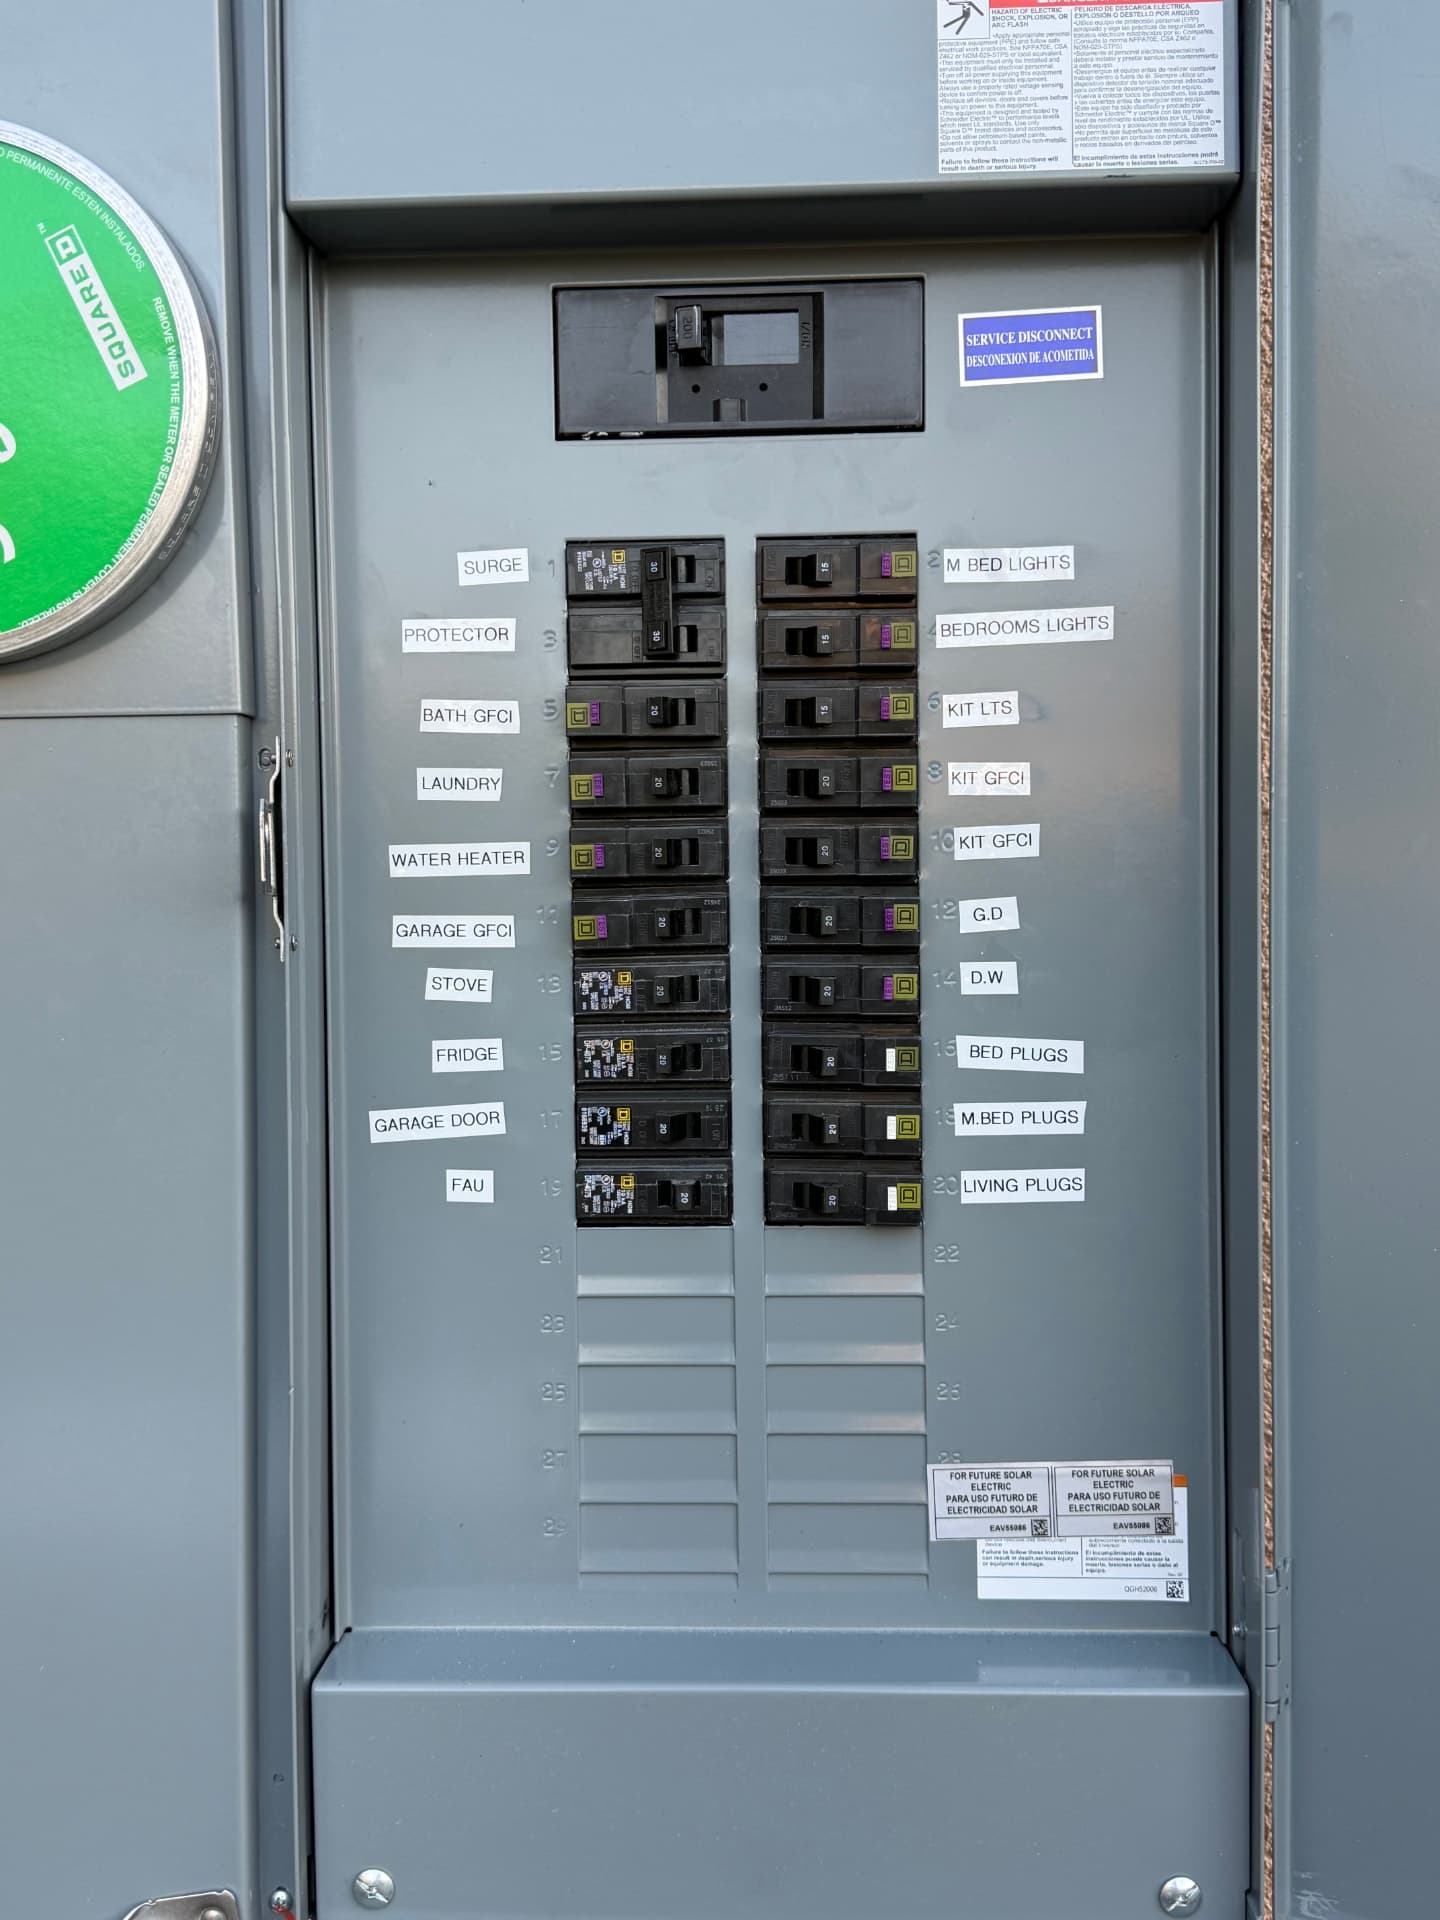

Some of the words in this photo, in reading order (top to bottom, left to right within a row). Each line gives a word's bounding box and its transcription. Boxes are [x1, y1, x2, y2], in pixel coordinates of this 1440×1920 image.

[6, 150, 74, 191] PERMANENTE
[72, 187, 102, 216] ESTEN
[100, 211, 146, 272] INSTALADOS.
[55, 235, 78, 260] D
[69, 264, 136, 379] SQUARE
[152, 296, 174, 345] REMOVE
[682, 316, 693, 339] 200
[966, 331, 1016, 347] SERVICE
[1018, 327, 1093, 344] DISCONNECT
[167, 345, 179, 380] WHEN
[966, 351, 1027, 368] DESCONEXION
[1029, 351, 1041, 364] DE
[1042, 348, 1095, 363] ACOMETIDA
[170, 381, 180, 404] THE
[167, 405, 180, 448] METER
[163, 446, 174, 463] OR
[148, 464, 170, 510] SEALED
[110, 507, 153, 564] PERMANENT
[464, 557, 523, 575] SURGE
[650, 560, 658, 573] 30
[821, 562, 829, 573] 15
[947, 557, 960, 572] M
[968, 557, 1002, 572] BED
[1009, 554, 1071, 571] LIGHTS
[84, 562, 115, 595] COVER
[73, 587, 84, 599] IS
[941, 619, 1040, 637] BEDROOMS
[1047, 615, 1109, 632] LIGHTS
[404, 627, 509, 642] PROTECTOR
[543, 630, 557, 648] 3
[653, 630, 661, 642] 30
[822, 634, 830, 645] 15
[543, 704, 558, 721] 5
[651, 705, 658, 717] 20
[821, 704, 829, 715] 15
[948, 702, 974, 717] KIT
[981, 700, 1012, 715] LTS
[423, 709, 466, 722] BATH
[474, 709, 513, 724] GFCI
[422, 777, 501, 791] LAUNDRY
[543, 768, 560, 788] 7
[655, 777, 662, 788] 20
[823, 775, 831, 787] 20
[952, 771, 978, 785] KIT
[984, 771, 1024, 785] GFCI
[546, 839, 559, 856] 9
[959, 835, 986, 849] KIT
[993, 833, 1032, 848] GFCI
[392, 853, 451, 867] WATER
[458, 850, 525, 866] HEATER
[655, 847, 662, 858] 20
[821, 845, 829, 857] 20
[825, 915, 833, 927] 20
[973, 907, 1003, 922] G.D
[658, 917, 666, 928] 20
[396, 925, 466, 938] GARAGE
[473, 924, 512, 937] GFCI
[432, 977, 488, 992] STOVE
[971, 970, 1003, 985] D.W
[656, 985, 664, 997] 20
[824, 985, 832, 997] 20
[436, 1047, 498, 1062] FRIDGE
[539, 1043, 561, 1061] 15
[970, 1044, 1003, 1059] BED
[1010, 1047, 1068, 1063] PLUGS
[659, 1055, 667, 1066] 20
[827, 1056, 835, 1067] 20
[374, 1114, 445, 1133] GARAGE
[451, 1111, 500, 1128] DOOR
[540, 1112, 563, 1128] 17
[961, 1111, 1014, 1126] M.BED
[1021, 1109, 1079, 1124] PLUGS
[660, 1123, 667, 1135] 20
[829, 1123, 837, 1135] 20
[452, 1178, 484, 1192] FAU
[932, 1177, 958, 1195] 20
[964, 1179, 1019, 1193] LIVING
[1026, 1177, 1083, 1192] PLUGS
[680, 1192, 689, 1204] 20
[829, 1195, 837, 1206] 20
[538, 1246, 563, 1264] 21
[934, 1245, 960, 1263] 22
[540, 1315, 566, 1334] 23
[541, 1383, 567, 1401] 25
[542, 1450, 567, 1470] 27
[950, 1472, 966, 1480] FOR
[969, 1471, 1001, 1480] FUTURE
[1003, 1471, 1032, 1479] SOLAR
[1071, 1470, 1089, 1478] FOR
[1091, 1469, 1124, 1478] FUTURE
[1126, 1469, 1155, 1477] SOLAR
[971, 1482, 1011, 1491] ELECTRIC
[1093, 1480, 1134, 1489] ELECTRIC
[946, 1494, 969, 1503] PARA
[971, 1494, 989, 1502] USO
[991, 1493, 1024, 1502] FUTURO
[1026, 1493, 1038, 1501] DE
[1067, 1492, 1091, 1501] PARA
[1093, 1492, 1111, 1500] USO
[1113, 1491, 1147, 1500] FUTURO
[1149, 1491, 1160, 1499] DE
[947, 1505, 1007, 1515] ELECTRICIDAD
[1009, 1505, 1038, 1513] SOLAR
[1068, 1503, 1129, 1513] ELECTRICIDAD
[1131, 1503, 1160, 1511] SOLAR
